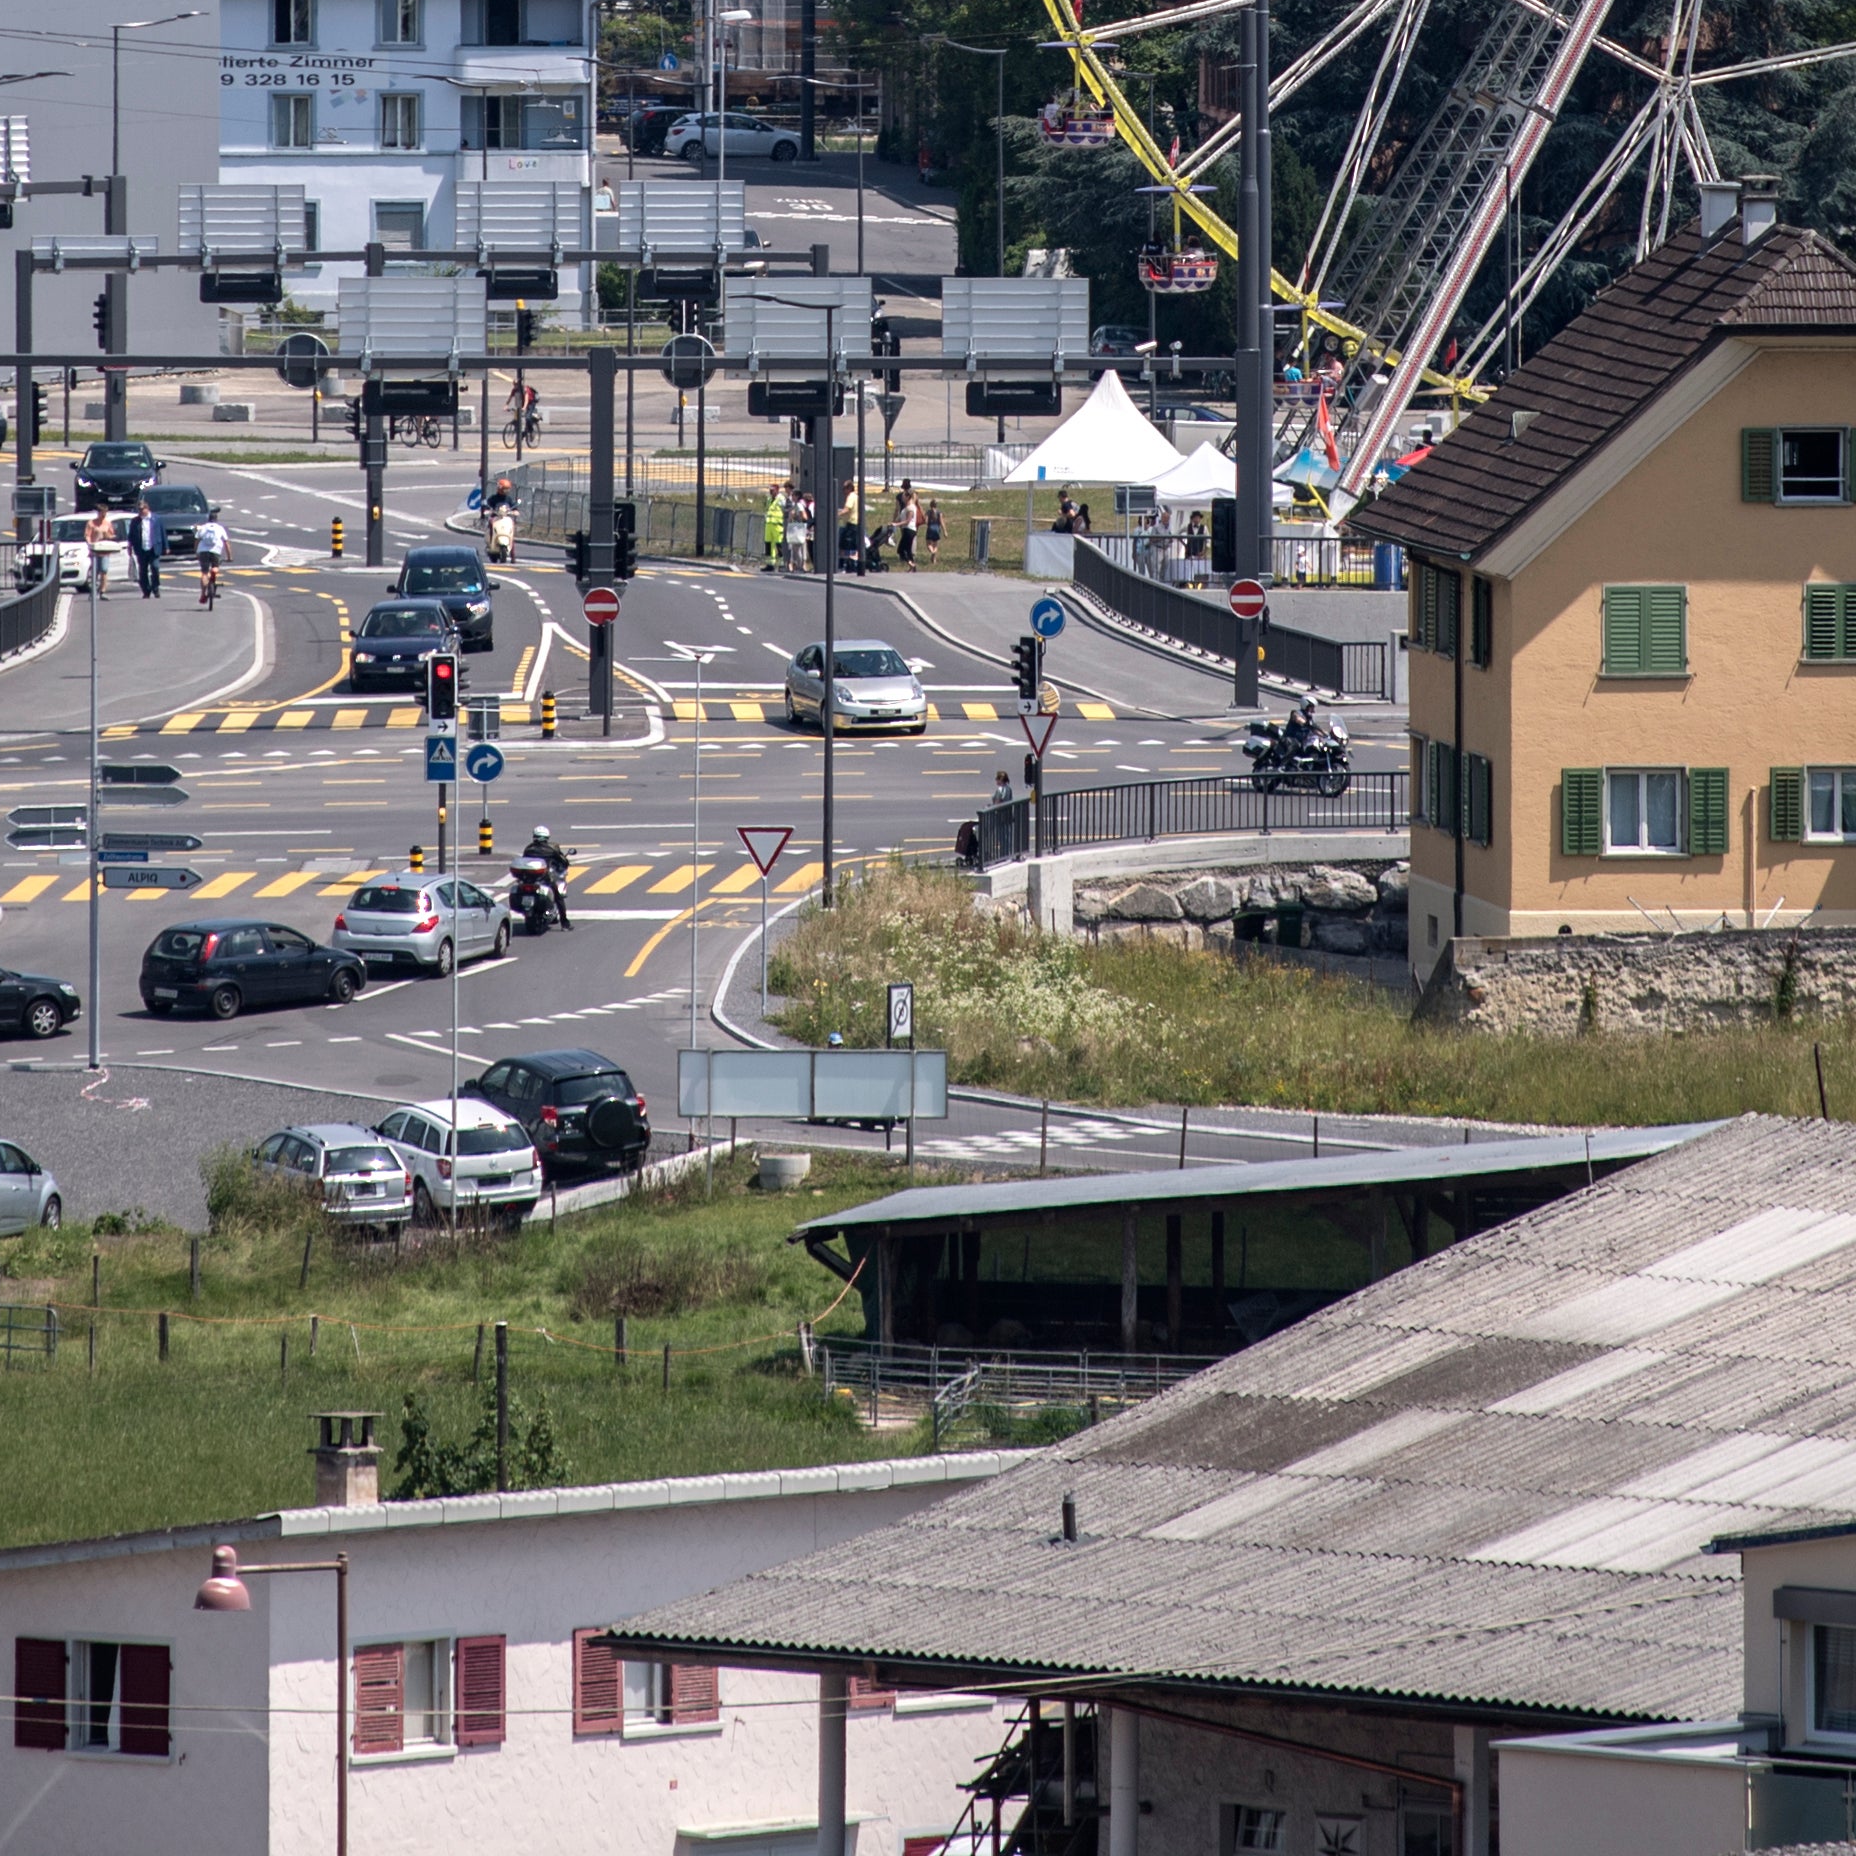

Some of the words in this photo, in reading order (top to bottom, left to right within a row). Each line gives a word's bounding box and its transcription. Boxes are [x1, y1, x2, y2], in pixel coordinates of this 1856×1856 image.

[219, 55, 279, 69] lierte
[289, 55, 377, 69] Zimmer
[221, 73, 235, 86] 9
[245, 73, 287, 86] 328
[296, 73, 320, 86] 16
[331, 73, 356, 86] 15
[128, 872, 158, 884] ALPIQ
